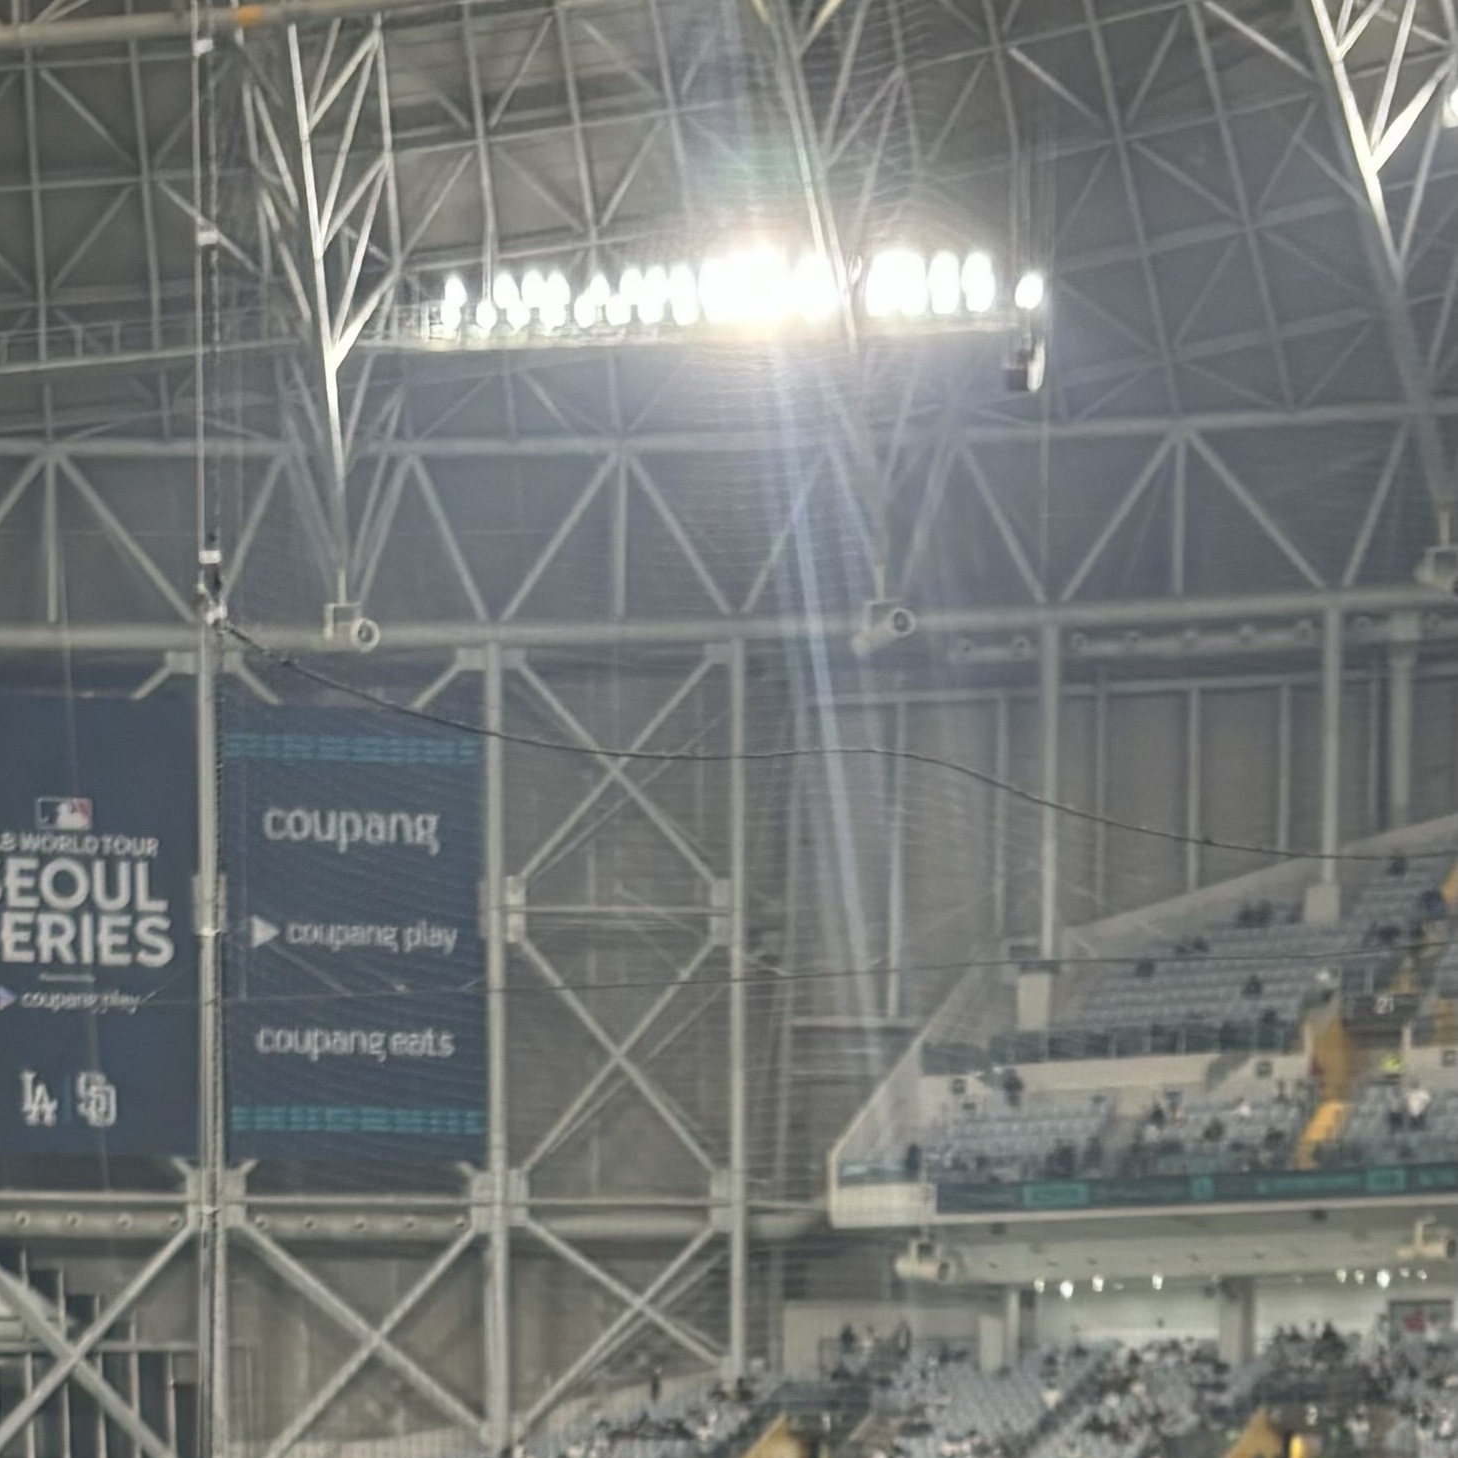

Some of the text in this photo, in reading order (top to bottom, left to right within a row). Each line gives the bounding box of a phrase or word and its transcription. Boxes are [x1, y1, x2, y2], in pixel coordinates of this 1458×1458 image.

[18, 832, 98, 855] WORLD
[99, 835, 159, 857] TOUR
[263, 807, 440, 857] coupang
[285, 920, 458, 955] coupang play
[256, 1026, 456, 1063] coupang eats
[21, 1070, 58, 1126] LA
